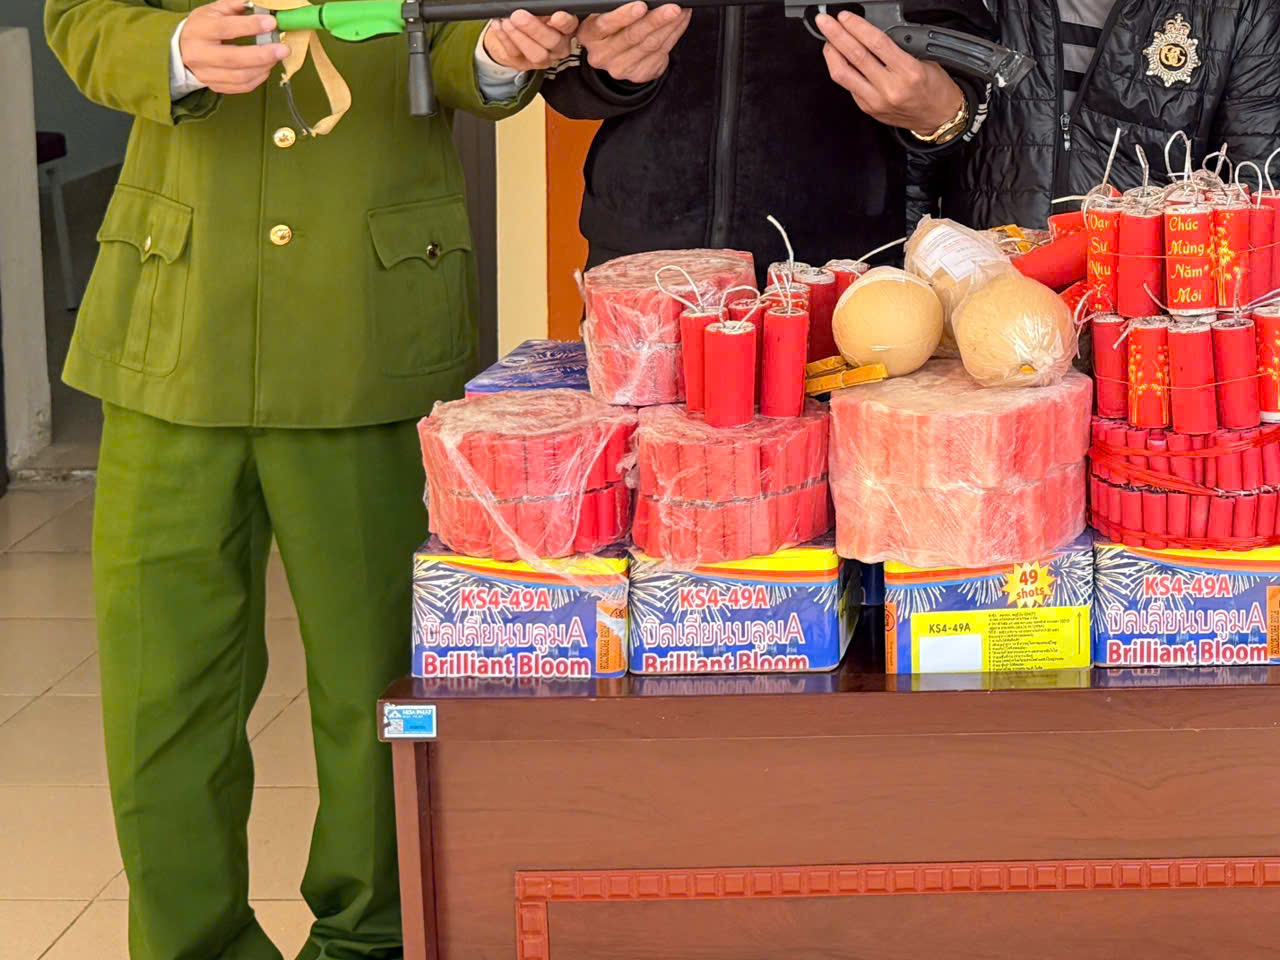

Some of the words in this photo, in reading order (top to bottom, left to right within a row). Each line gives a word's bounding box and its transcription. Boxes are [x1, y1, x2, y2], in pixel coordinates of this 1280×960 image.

[1169, 216, 1199, 231] Chúc
[1171, 263, 1203, 279] Năm
[1019, 569, 1038, 586] 49
[1144, 575, 1233, 598] KS4-49A
[460, 588, 552, 611] KS4-49A
[680, 586, 770, 610] KS4-49A
[1016, 586, 1045, 600] shots
[929, 623, 971, 634] KS4-49A
[643, 653, 733, 672] Brilliant
[737, 652, 809, 671] Bloom
[1107, 640, 1197, 664] Brilliant
[1200, 640, 1268, 664] Bloom
[424, 652, 515, 676] Brilliant
[518, 652, 590, 677] Bloom
